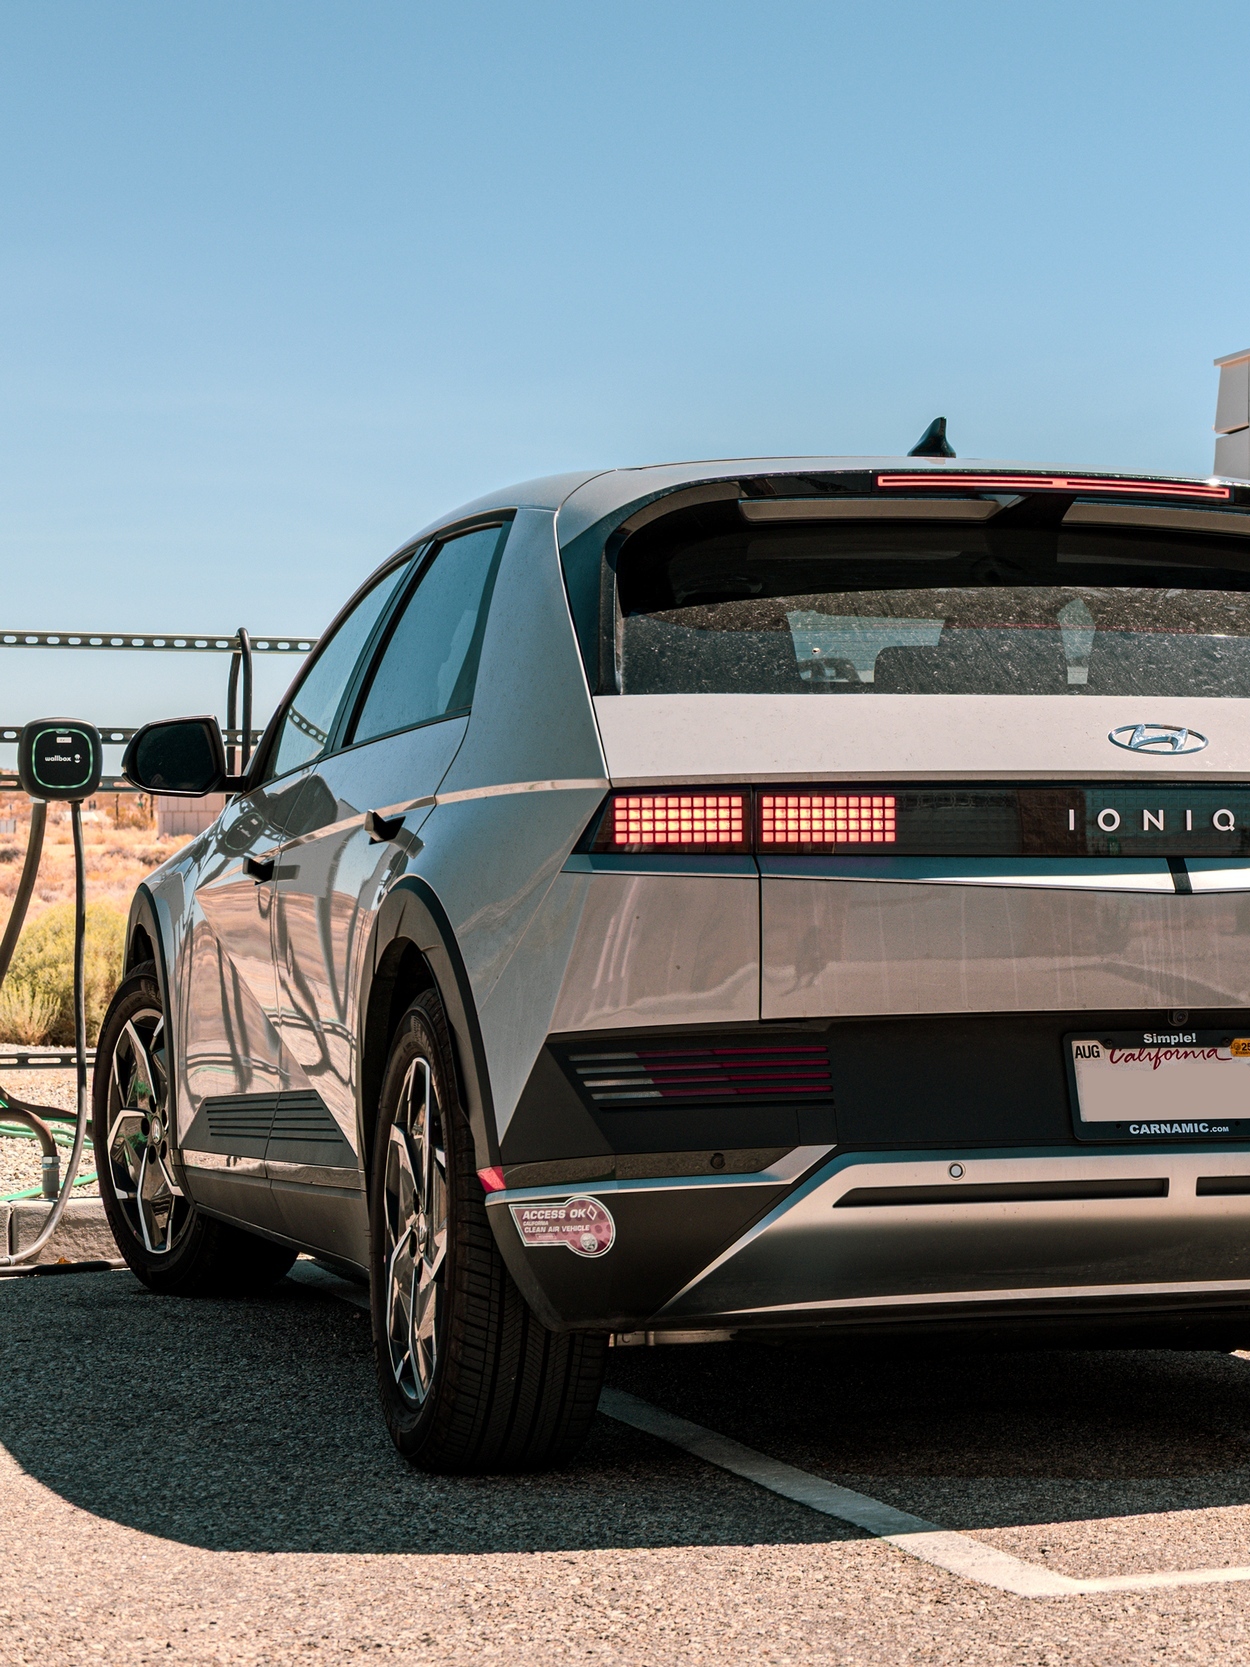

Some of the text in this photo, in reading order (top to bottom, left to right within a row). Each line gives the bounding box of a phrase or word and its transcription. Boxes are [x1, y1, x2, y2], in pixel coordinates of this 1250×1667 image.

[1143, 1032, 1198, 1046] Simple!
[1075, 1045, 1100, 1059] AUG
[1109, 1047, 1233, 1070] California
[522, 1208, 587, 1220] ACCESS OK
[561, 1224, 591, 1232] VEHICLE
